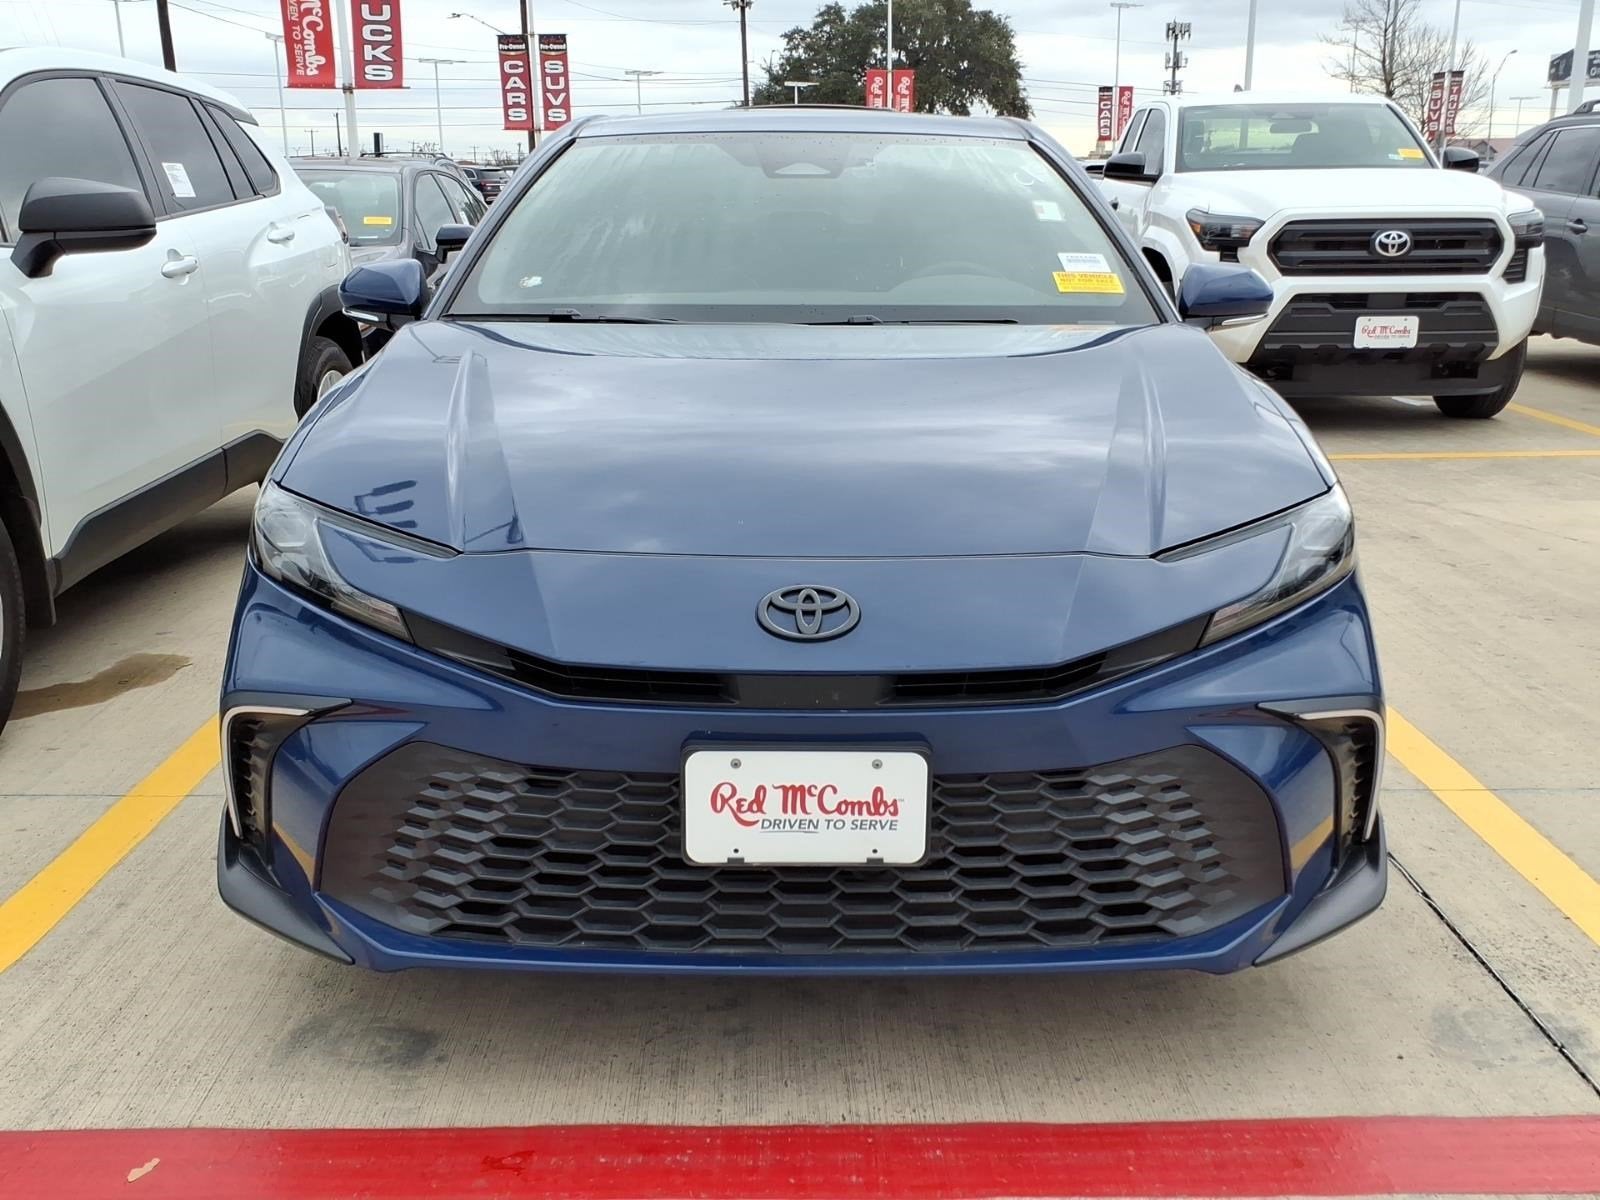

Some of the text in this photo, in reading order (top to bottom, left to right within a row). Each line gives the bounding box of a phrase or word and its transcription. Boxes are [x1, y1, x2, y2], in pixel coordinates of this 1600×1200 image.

[292, 25, 301, 40] TO
[293, 43, 305, 76] SERVE
[504, 60, 528, 121] CARS
[544, 60, 568, 122] SUVS
[1429, 89, 1442, 131] SUVS
[1446, 86, 1460, 133] TRUCKS
[1100, 101, 1111, 136] CARS
[710, 782, 899, 827] Red McCombs
[760, 818, 899, 831] DRIVEN TO SERVE
